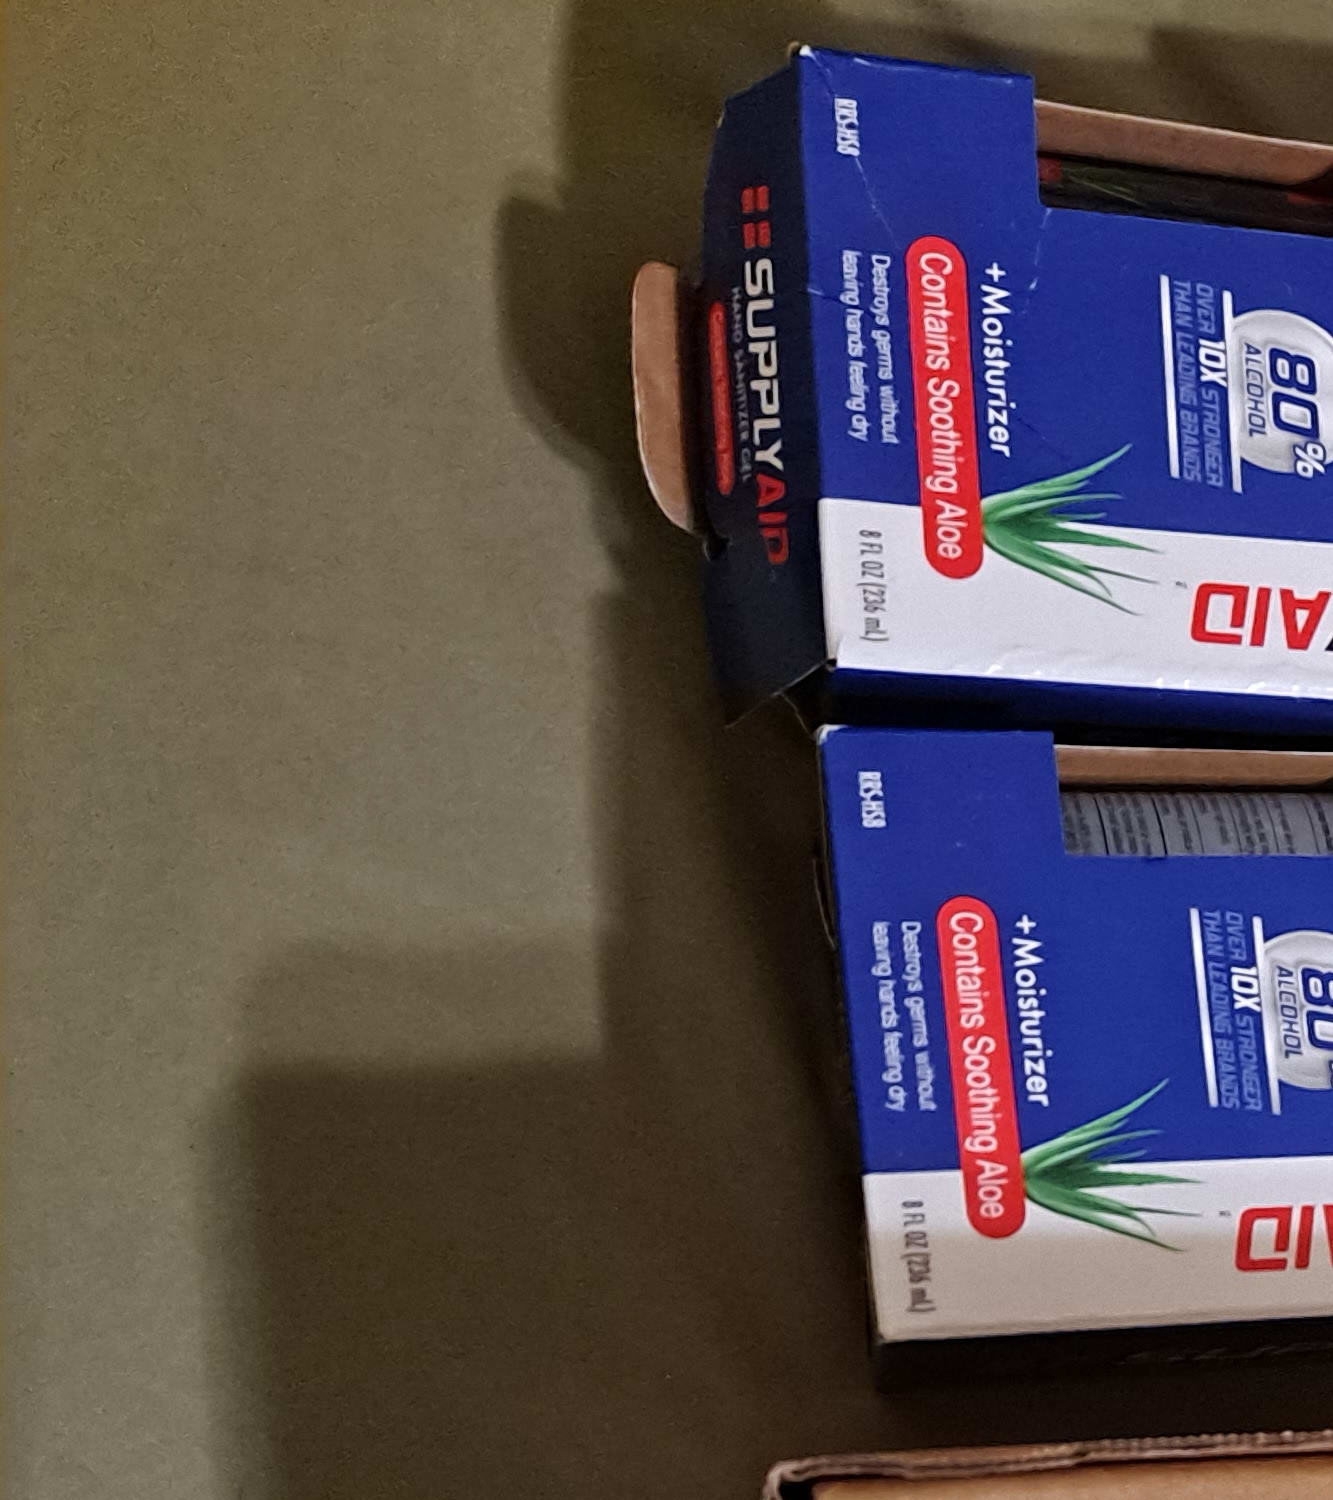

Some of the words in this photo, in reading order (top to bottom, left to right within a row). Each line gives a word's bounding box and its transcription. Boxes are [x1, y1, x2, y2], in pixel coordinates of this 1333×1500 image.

[838, 250, 863, 305] leaving
[869, 254, 892, 325] Destroys
[1173, 280, 1192, 327] THAN
[729, 286, 745, 342] HAND
[844, 309, 866, 357] hands
[918, 252, 955, 370] Contains
[1195, 283, 1216, 334] OVER
[870, 330, 894, 380] germs
[979, 262, 1017, 458] +Moisturizer
[1175, 331, 1197, 406] LEADING
[1198, 339, 1228, 387] 10X
[731, 348, 751, 441] SANITIZER
[743, 258, 790, 565] SUPPLYAID
[845, 360, 868, 412] feeling
[1243, 343, 1266, 437] ALCOHOL
[1268, 347, 1326, 478] 80%
[847, 414, 870, 443] dry
[878, 385, 900, 444] without
[923, 376, 964, 493] Soothing
[1200, 387, 1224, 487] STRONGER
[737, 447, 753, 484] GEL
[1179, 409, 1201, 483] BRANDS
[857, 529, 882, 539] 8
[858, 542, 884, 555] FL
[934, 499, 969, 560] Aloe
[855, 583, 888, 612] (236
[859, 560, 886, 579] OZ
[858, 617, 890, 642] mL)
[869, 921, 894, 977] leaving
[899, 921, 924, 992] Destroys
[1201, 910, 1223, 956] THAN
[1224, 911, 1247, 961] OVER
[948, 911, 991, 1029] Contains
[1207, 961, 1231, 1035] LEADING
[1229, 966, 1262, 1013] 10X
[877, 980, 901, 1029] hands
[902, 996, 930, 1048] germs
[1011, 914, 1052, 1107] +Moisturizer
[1275, 966, 1303, 1059] ALCOHOL
[880, 1031, 904, 1083] feeling
[913, 1052, 938, 1112] without
[1214, 1038, 1240, 1109] BRANDS
[1234, 1014, 1263, 1112] STRONGER
[883, 1085, 908, 1112] dry
[961, 1034, 1003, 1152] Soothing
[974, 1159, 1009, 1218] Aloe
[901, 1212, 926, 1226] FL
[904, 1231, 928, 1249] OZ
[899, 1252, 932, 1284] (236
